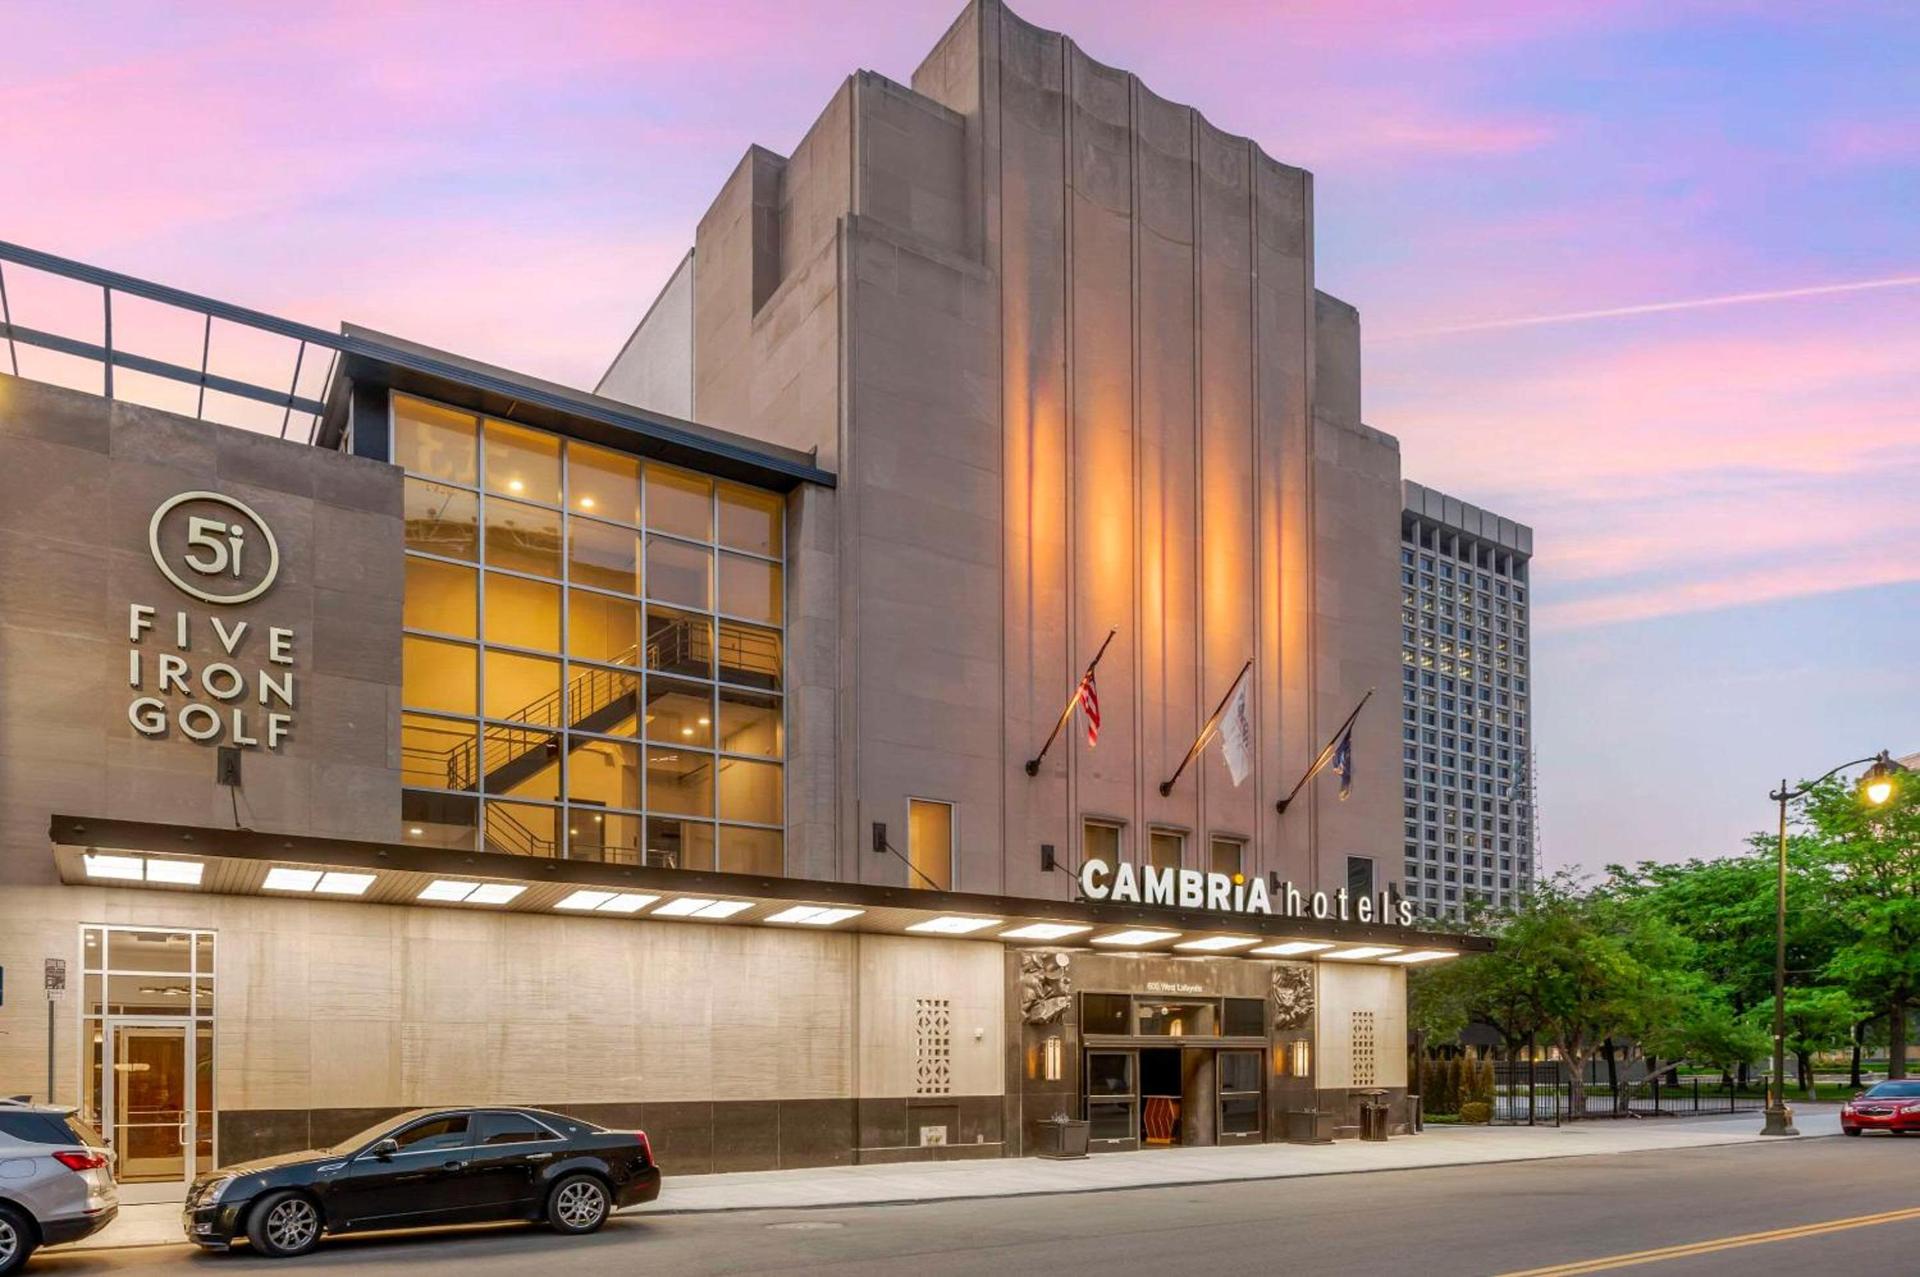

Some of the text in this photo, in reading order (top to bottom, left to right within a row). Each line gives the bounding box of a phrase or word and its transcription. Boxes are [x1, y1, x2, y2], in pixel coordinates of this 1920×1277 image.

[184, 516, 244, 576] 5i
[129, 603, 294, 664] FIVE
[129, 649, 293, 706] IRON
[128, 697, 291, 748] GOLF
[1287, 881, 1412, 926] hotels
